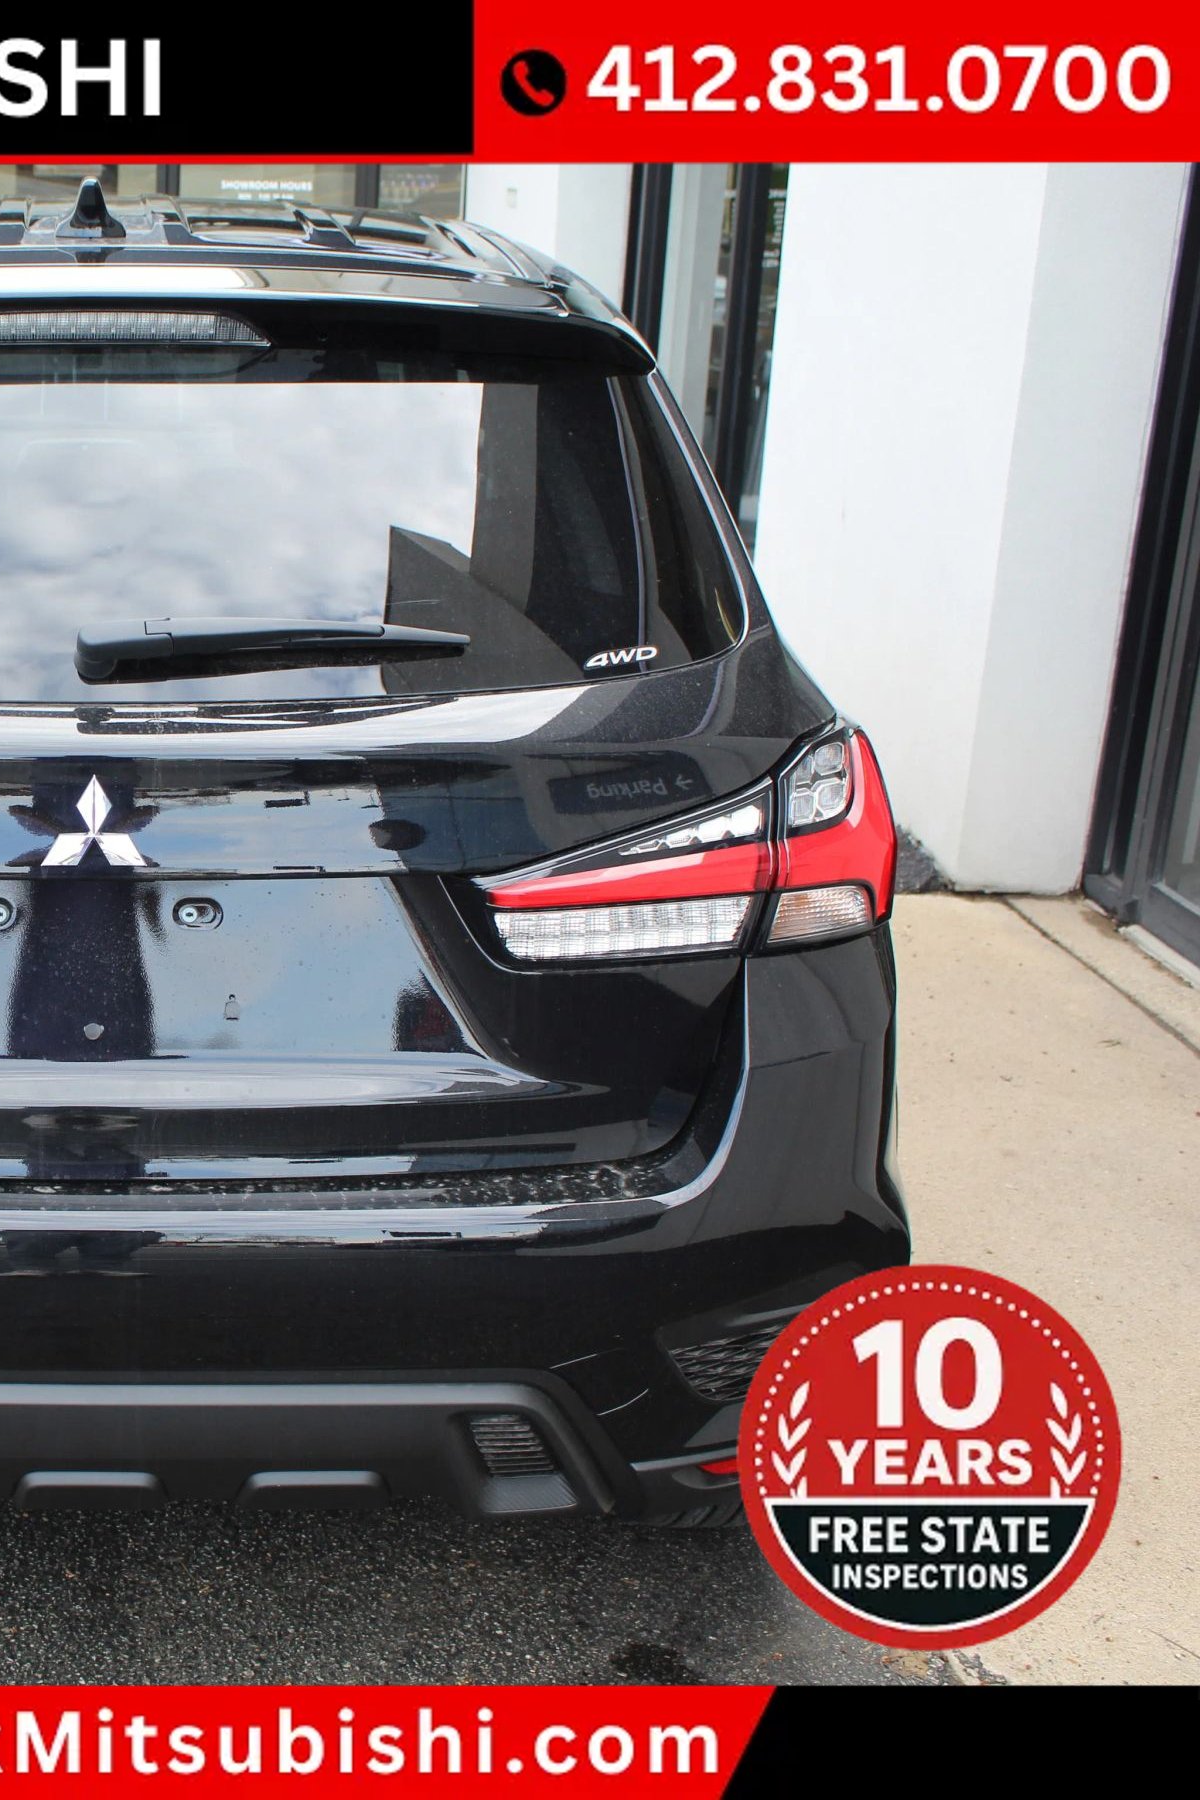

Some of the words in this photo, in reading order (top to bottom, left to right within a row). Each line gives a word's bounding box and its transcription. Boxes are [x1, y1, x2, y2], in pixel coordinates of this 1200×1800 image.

[221, 179, 279, 191] SHOWROOM
[280, 180, 313, 192] HOURS
[585, 646, 658, 668] 4WD
[586, 776, 668, 799] Parking
